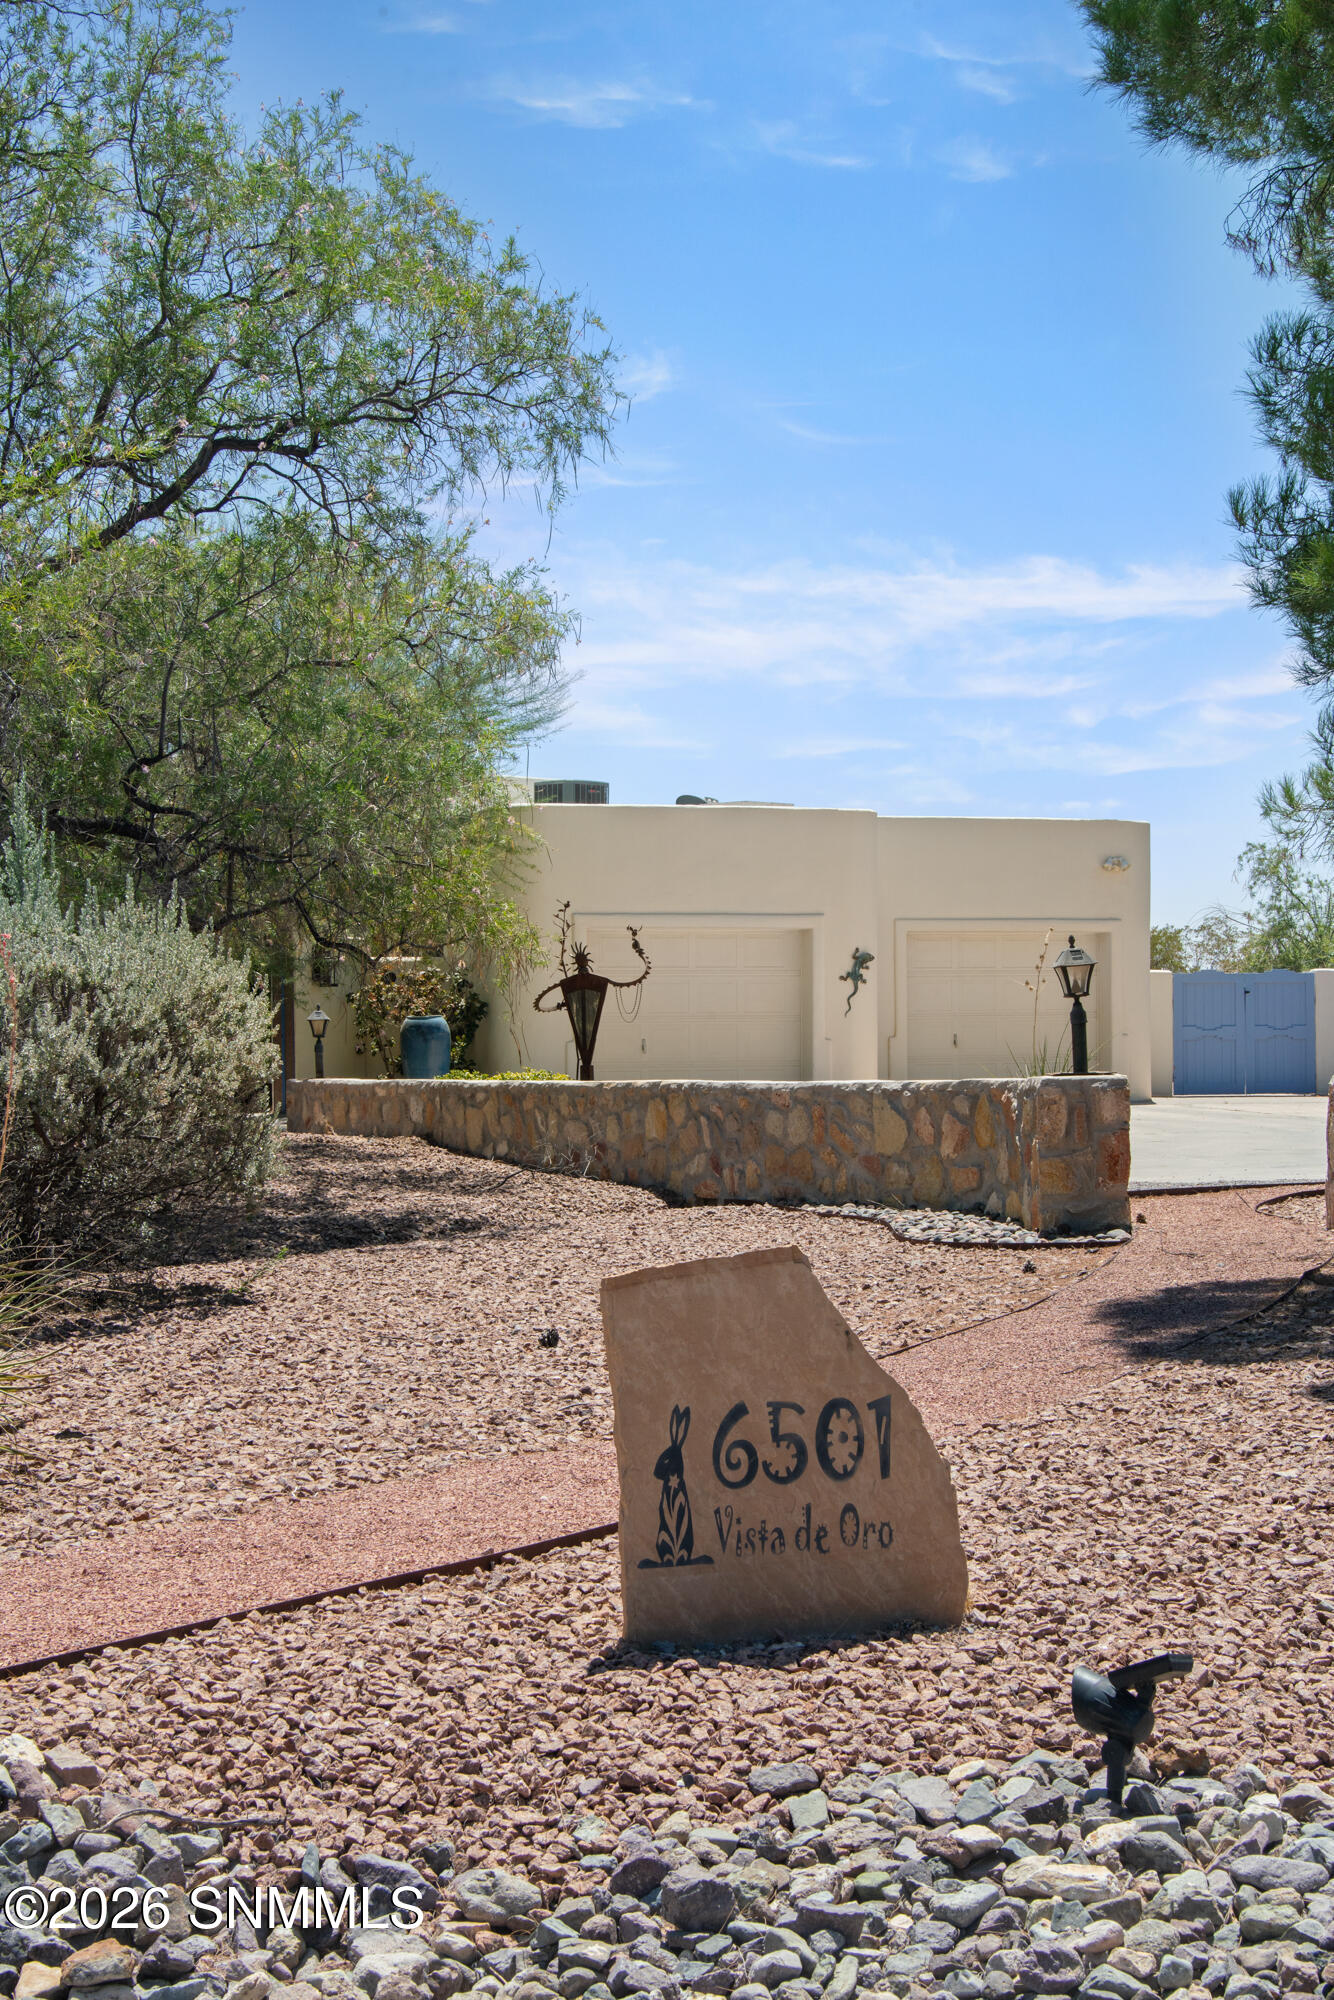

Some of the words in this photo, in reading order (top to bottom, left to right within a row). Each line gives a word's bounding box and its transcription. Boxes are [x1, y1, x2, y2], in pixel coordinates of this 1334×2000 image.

[712, 1394, 892, 1489] 6501
[713, 1504, 786, 1557] Vista
[795, 1502, 830, 1555] de
[839, 1502, 895, 1550] Oro
